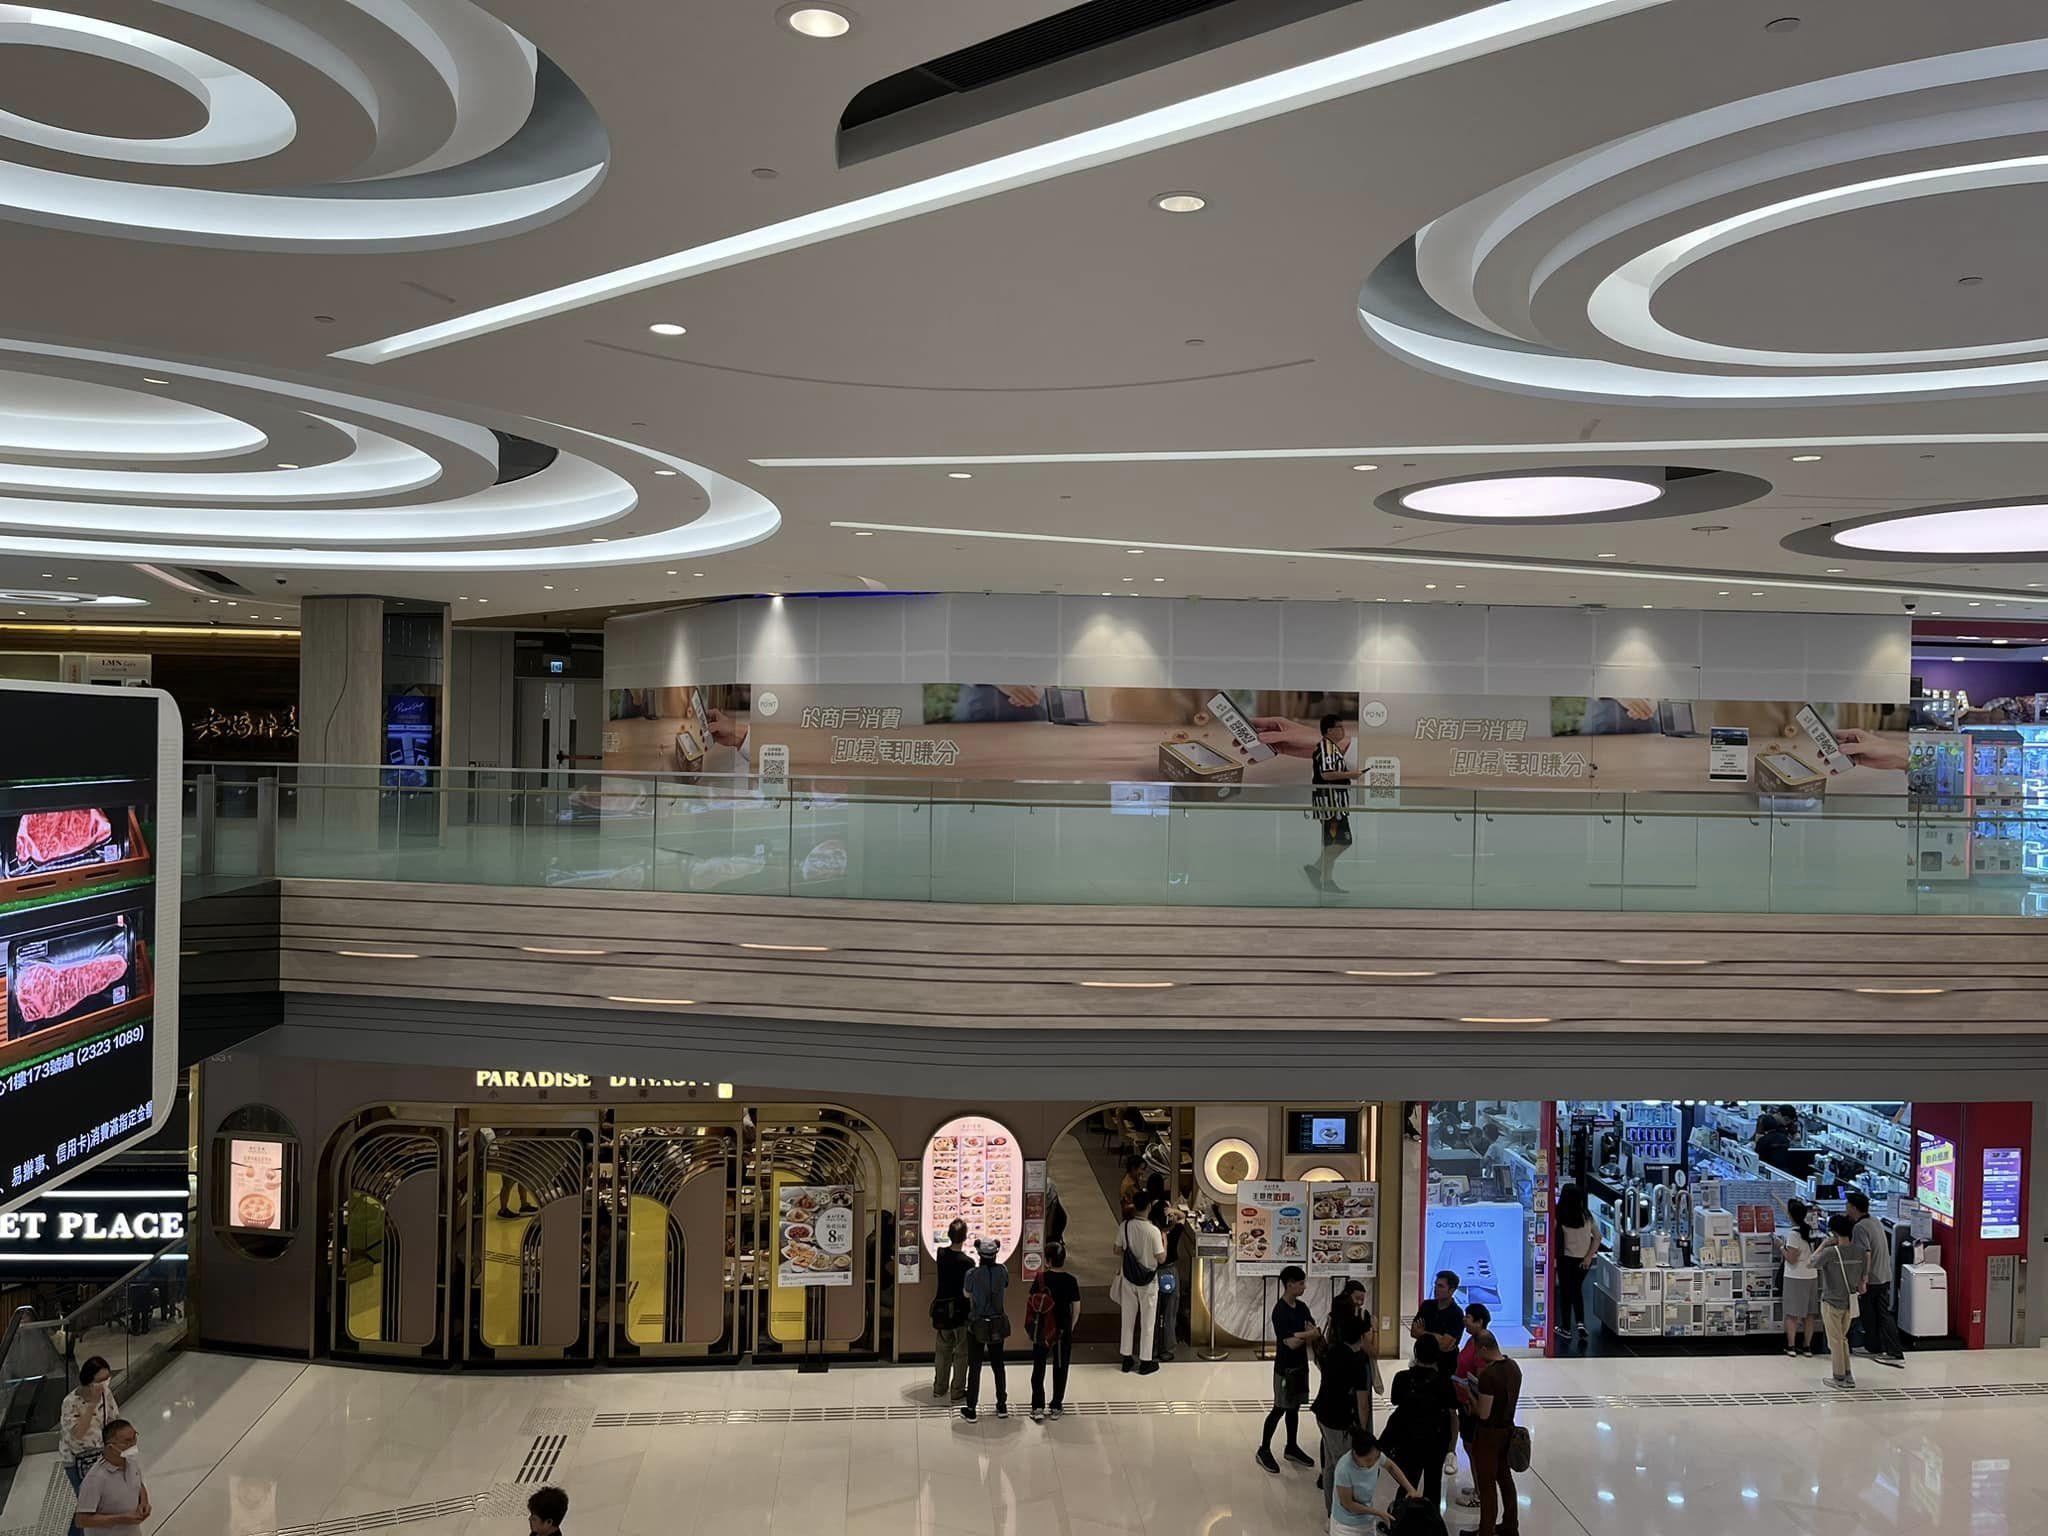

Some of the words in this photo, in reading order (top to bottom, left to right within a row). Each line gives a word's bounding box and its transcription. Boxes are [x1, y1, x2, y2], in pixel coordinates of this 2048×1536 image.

[800, 707, 903, 730] 於商戶消費
[1414, 717, 1529, 742] 於商戶消費
[77, 1041, 111, 1066] (2323
[113, 1025, 145, 1048] 1089)
[476, 1070, 592, 1087] PARADISE
[58, 1212, 184, 1239] PLACE
[1436, 1221, 1463, 1229] Galaxy
